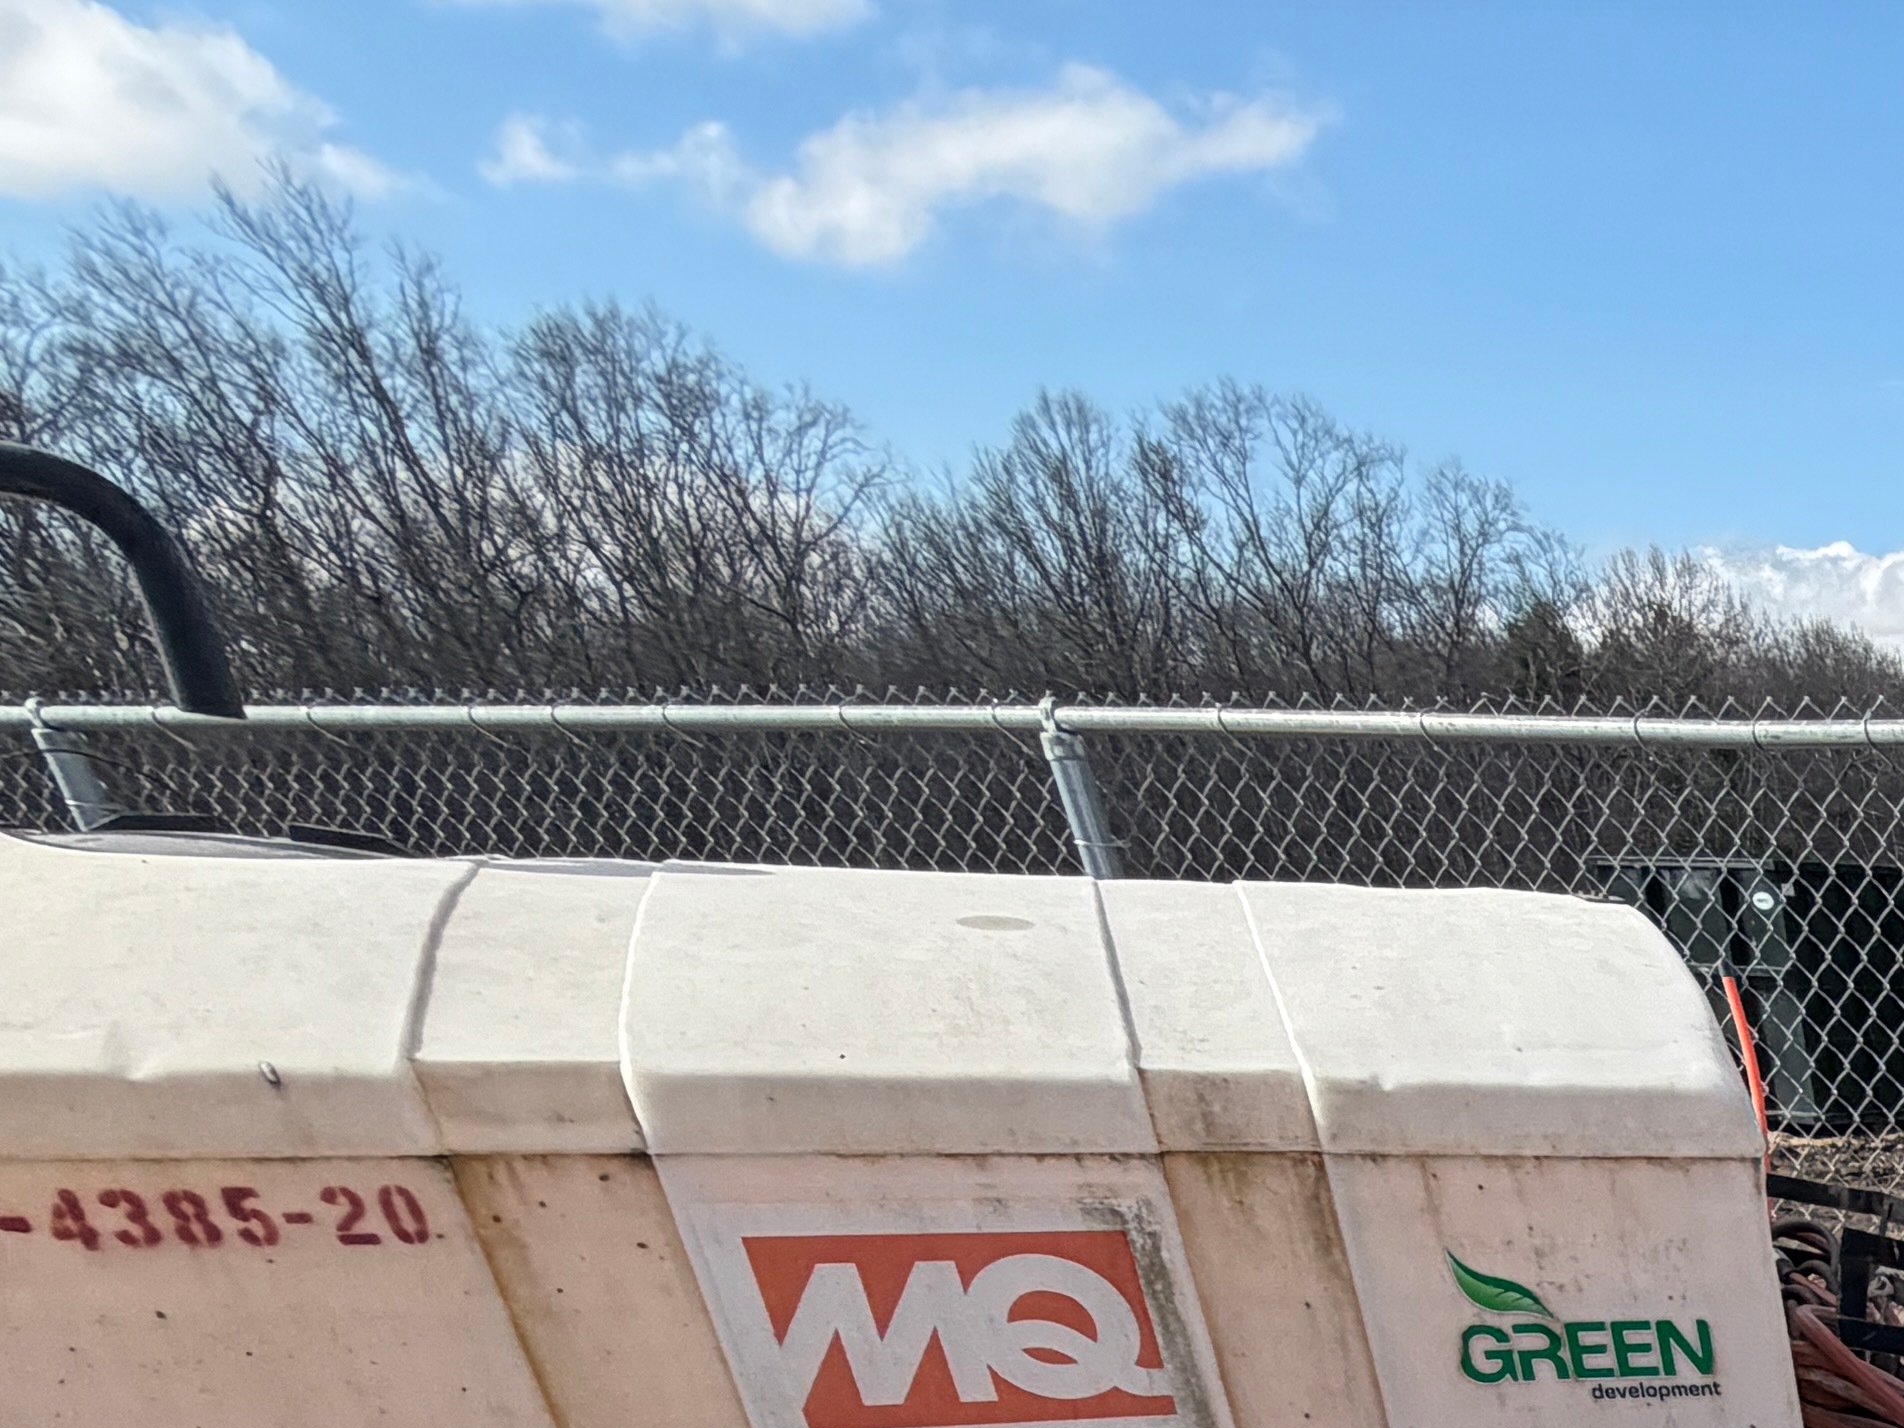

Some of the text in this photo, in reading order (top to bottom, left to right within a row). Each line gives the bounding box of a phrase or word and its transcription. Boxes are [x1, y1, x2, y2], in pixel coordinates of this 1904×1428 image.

[773, 1252, 1174, 1407] MQ
[1460, 1319, 1715, 1384] GREEN
[1591, 1382, 1722, 1401] development
